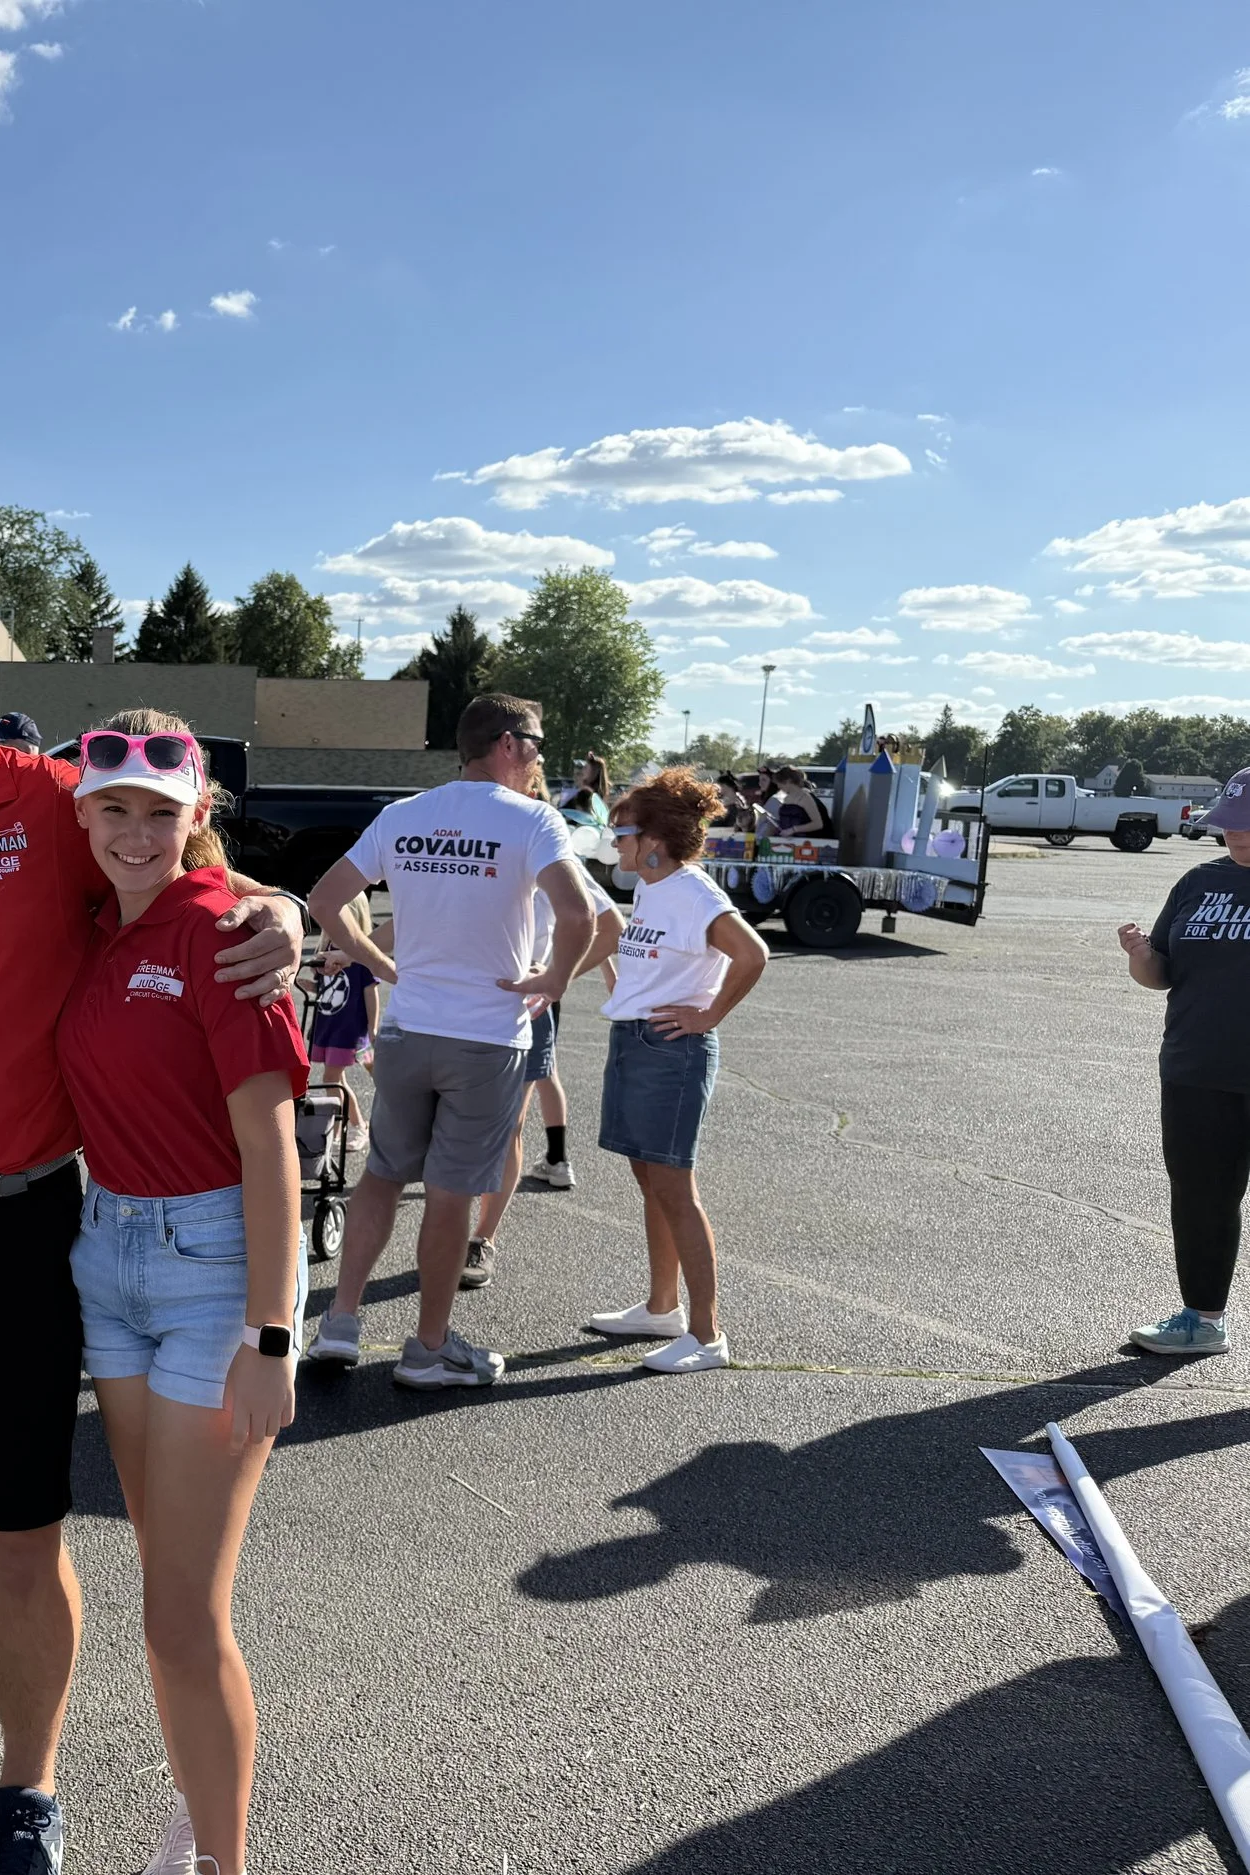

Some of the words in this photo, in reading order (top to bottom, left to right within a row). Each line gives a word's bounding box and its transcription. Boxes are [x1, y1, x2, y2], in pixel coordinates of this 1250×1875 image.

[433, 829, 462, 837] ADAM
[395, 836, 501, 860] COVAULT
[403, 860, 480, 876] ASSESSOR
[1202, 892, 1234, 905] TIM
[1185, 926, 1208, 936] FOR
[136, 964, 176, 977] FREEMAN
[136, 979, 171, 993] JUDGE
[151, 992, 171, 1001] COURT
